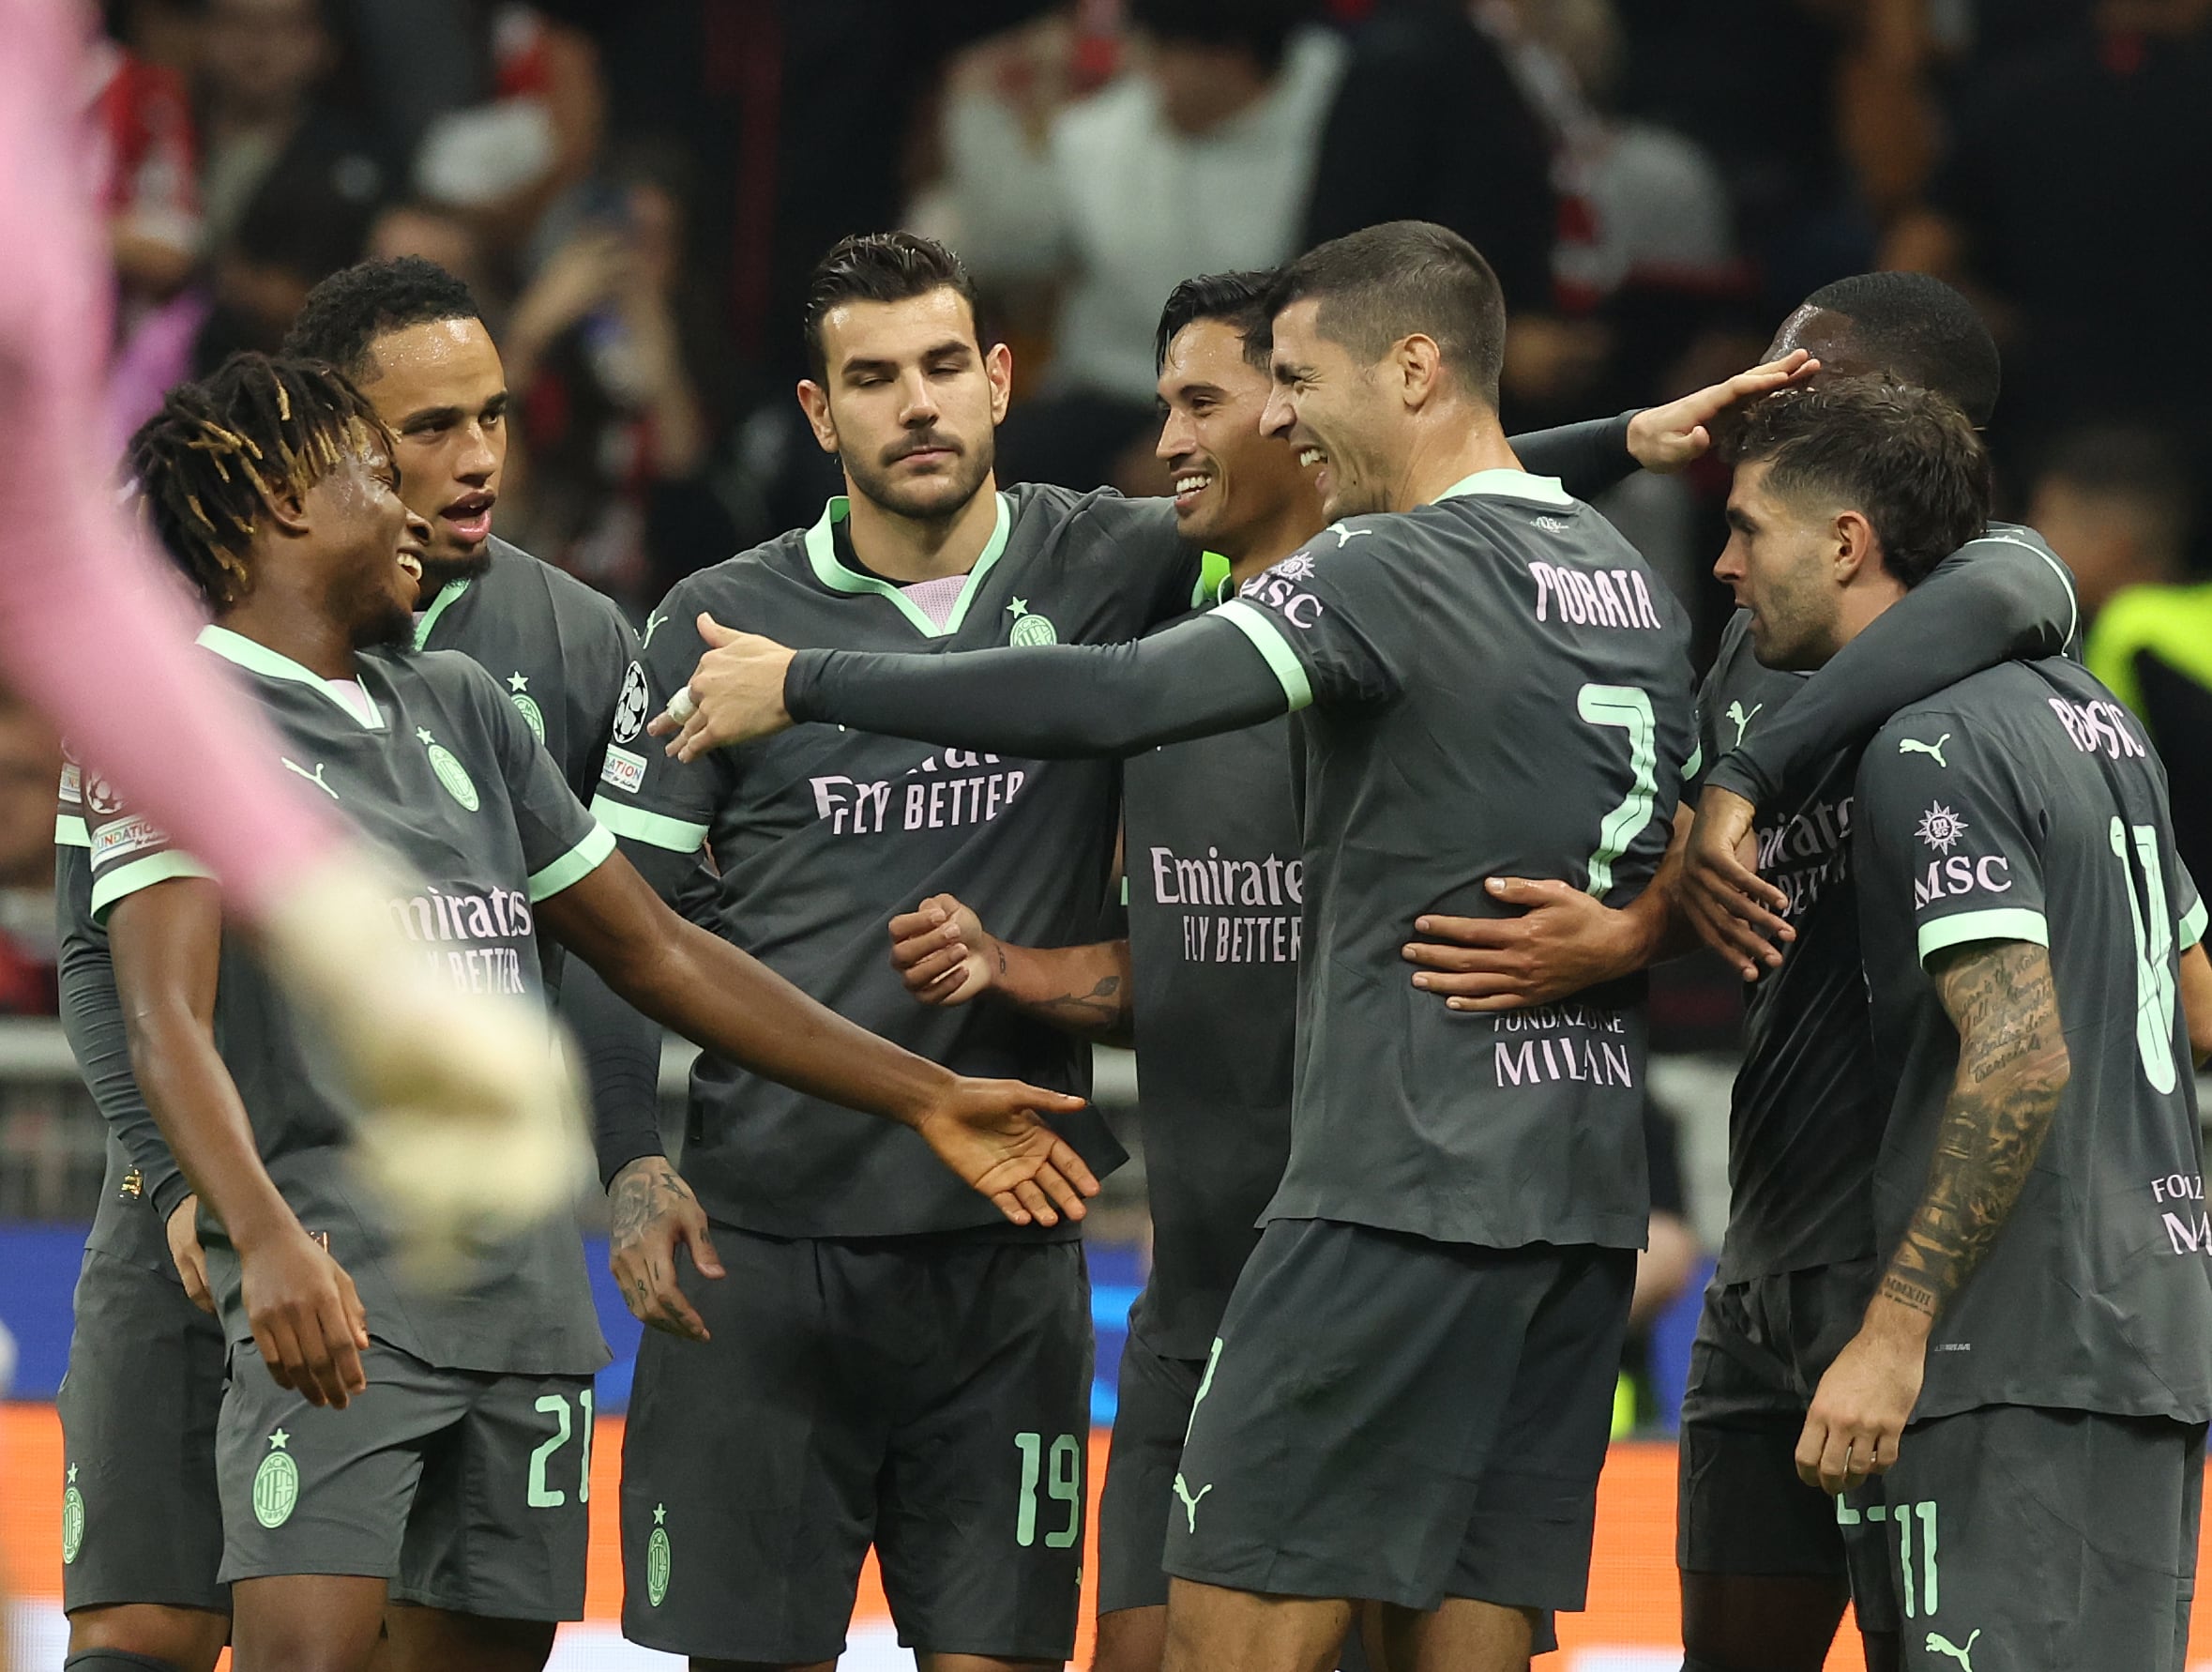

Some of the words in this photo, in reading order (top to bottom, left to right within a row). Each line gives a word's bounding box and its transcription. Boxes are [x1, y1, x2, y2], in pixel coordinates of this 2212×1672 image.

[1528, 562, 1661, 630] MORATA
[1577, 683, 1658, 901] 7
[1150, 846, 1303, 905] Emirate
[1915, 855, 2012, 911] MSC
[1183, 916, 1209, 962] FLY
[1215, 917, 1302, 963] BETTER
[1494, 1038, 1632, 1087] MILAN
[527, 1389, 593, 1508] 21
[1014, 1432, 1080, 1548] 19
[1894, 1500, 1938, 1619] 11
